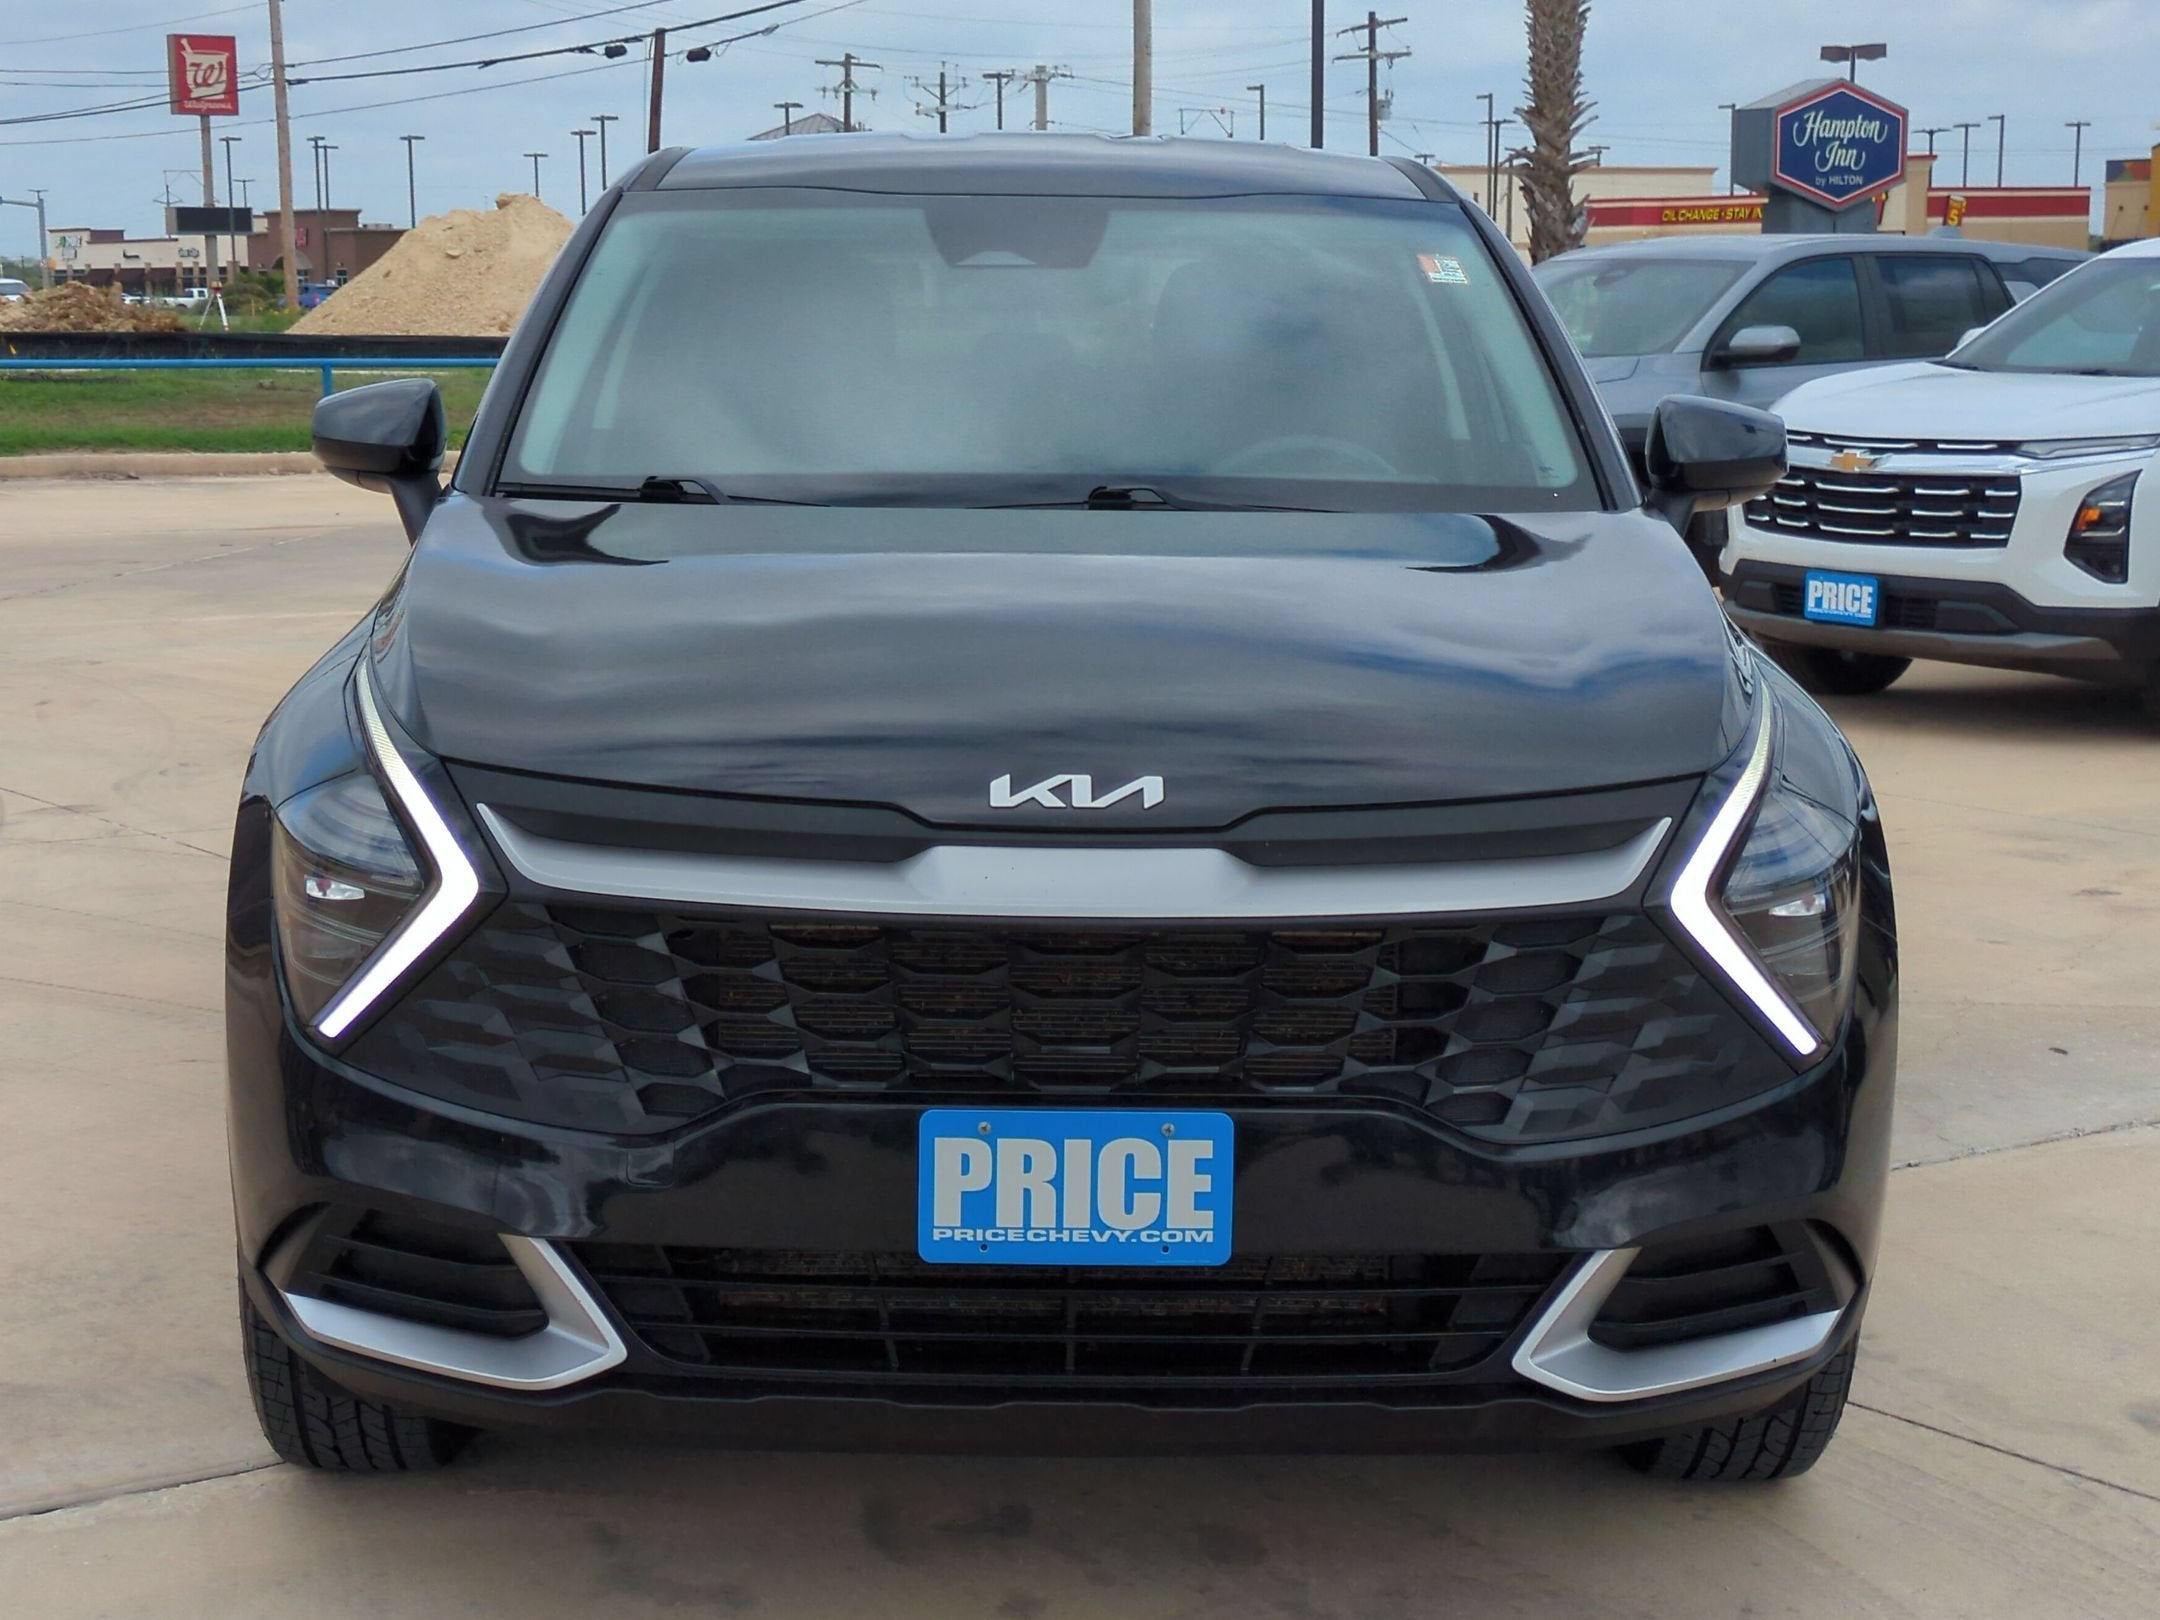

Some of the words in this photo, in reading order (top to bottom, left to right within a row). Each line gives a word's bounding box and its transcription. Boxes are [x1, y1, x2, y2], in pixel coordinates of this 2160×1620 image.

[1793, 110, 1888, 147] Hampton
[1814, 141, 1866, 172] Inn
[1815, 176, 1826, 187] by
[1828, 175, 1863, 185] HILTON
[1678, 208, 1720, 221] CHANGE
[1725, 207, 1750, 220] STAY
[1808, 580, 1873, 614] PRICE
[990, 773, 1164, 809] KIA
[933, 1137, 1214, 1230] PRICE
[932, 1227, 1214, 1243] PRICECHEVY.COM
